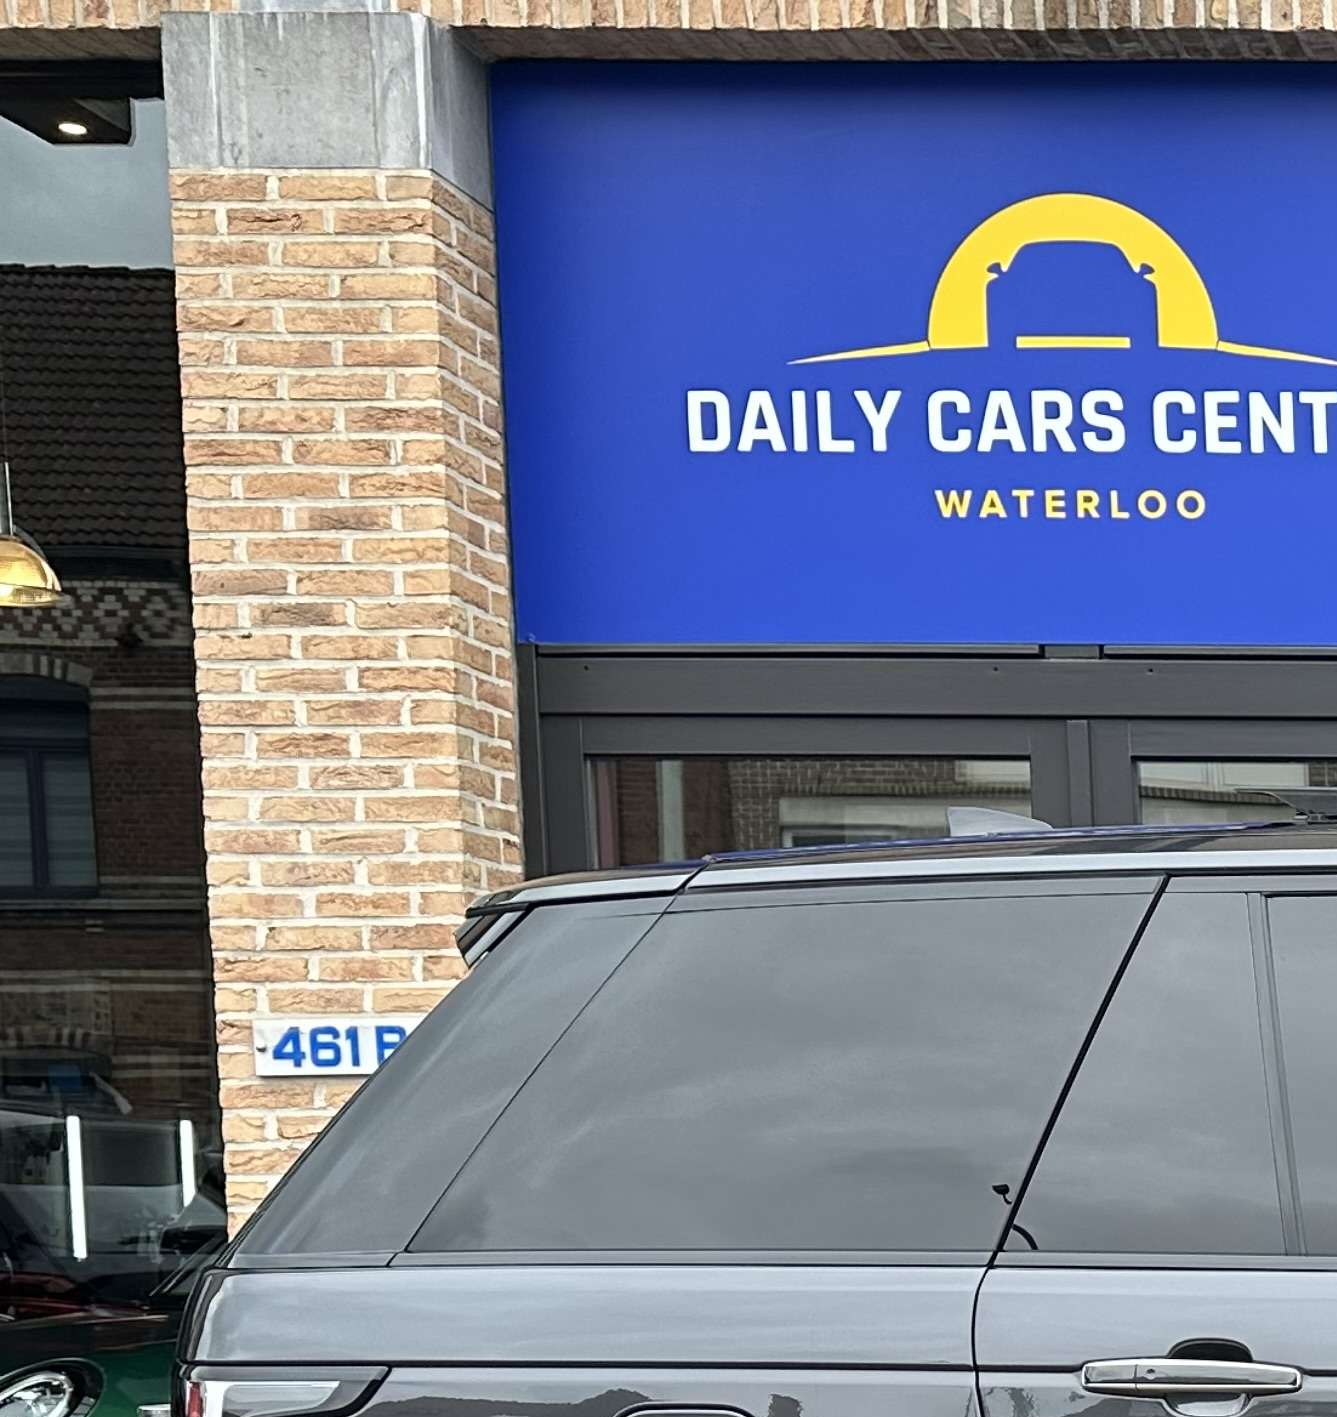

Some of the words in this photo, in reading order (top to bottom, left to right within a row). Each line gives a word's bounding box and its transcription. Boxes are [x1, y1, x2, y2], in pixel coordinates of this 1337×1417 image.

[686, 389, 902, 453] DAILY
[927, 389, 1127, 454] CARS
[934, 489, 1207, 520] WATERLOO
[272, 1025, 361, 1068] 461
